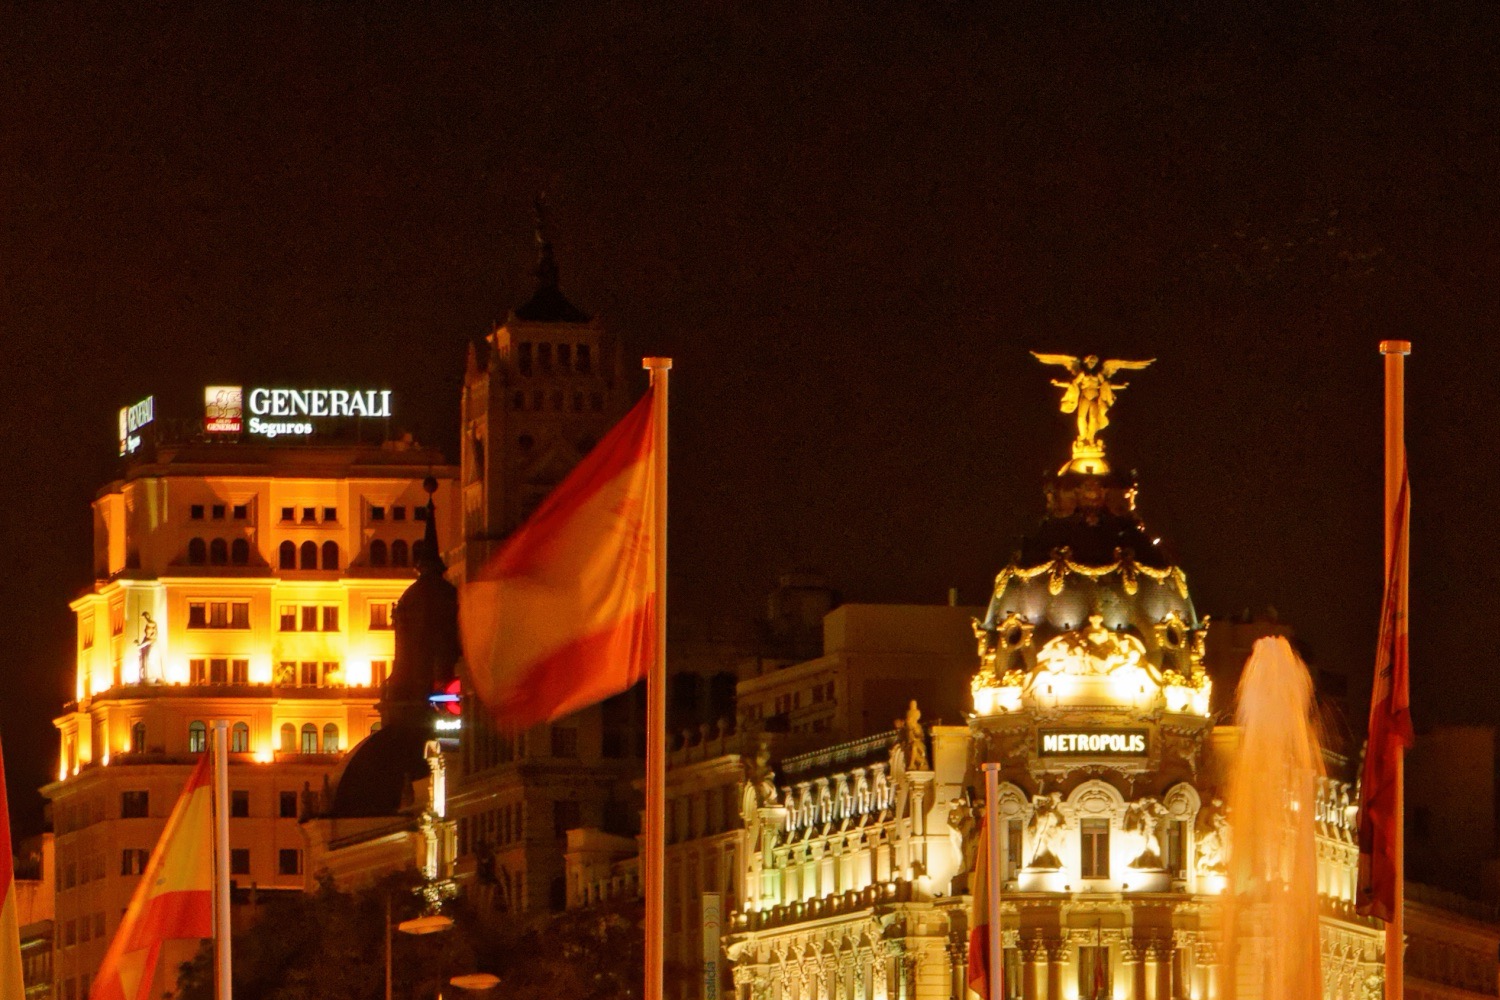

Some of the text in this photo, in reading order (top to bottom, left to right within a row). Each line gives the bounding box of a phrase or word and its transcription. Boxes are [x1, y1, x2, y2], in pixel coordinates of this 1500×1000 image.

[249, 387, 392, 417] GENERALI
[249, 417, 313, 437] Seguros
[1043, 734, 1146, 752] METROPOLIS
